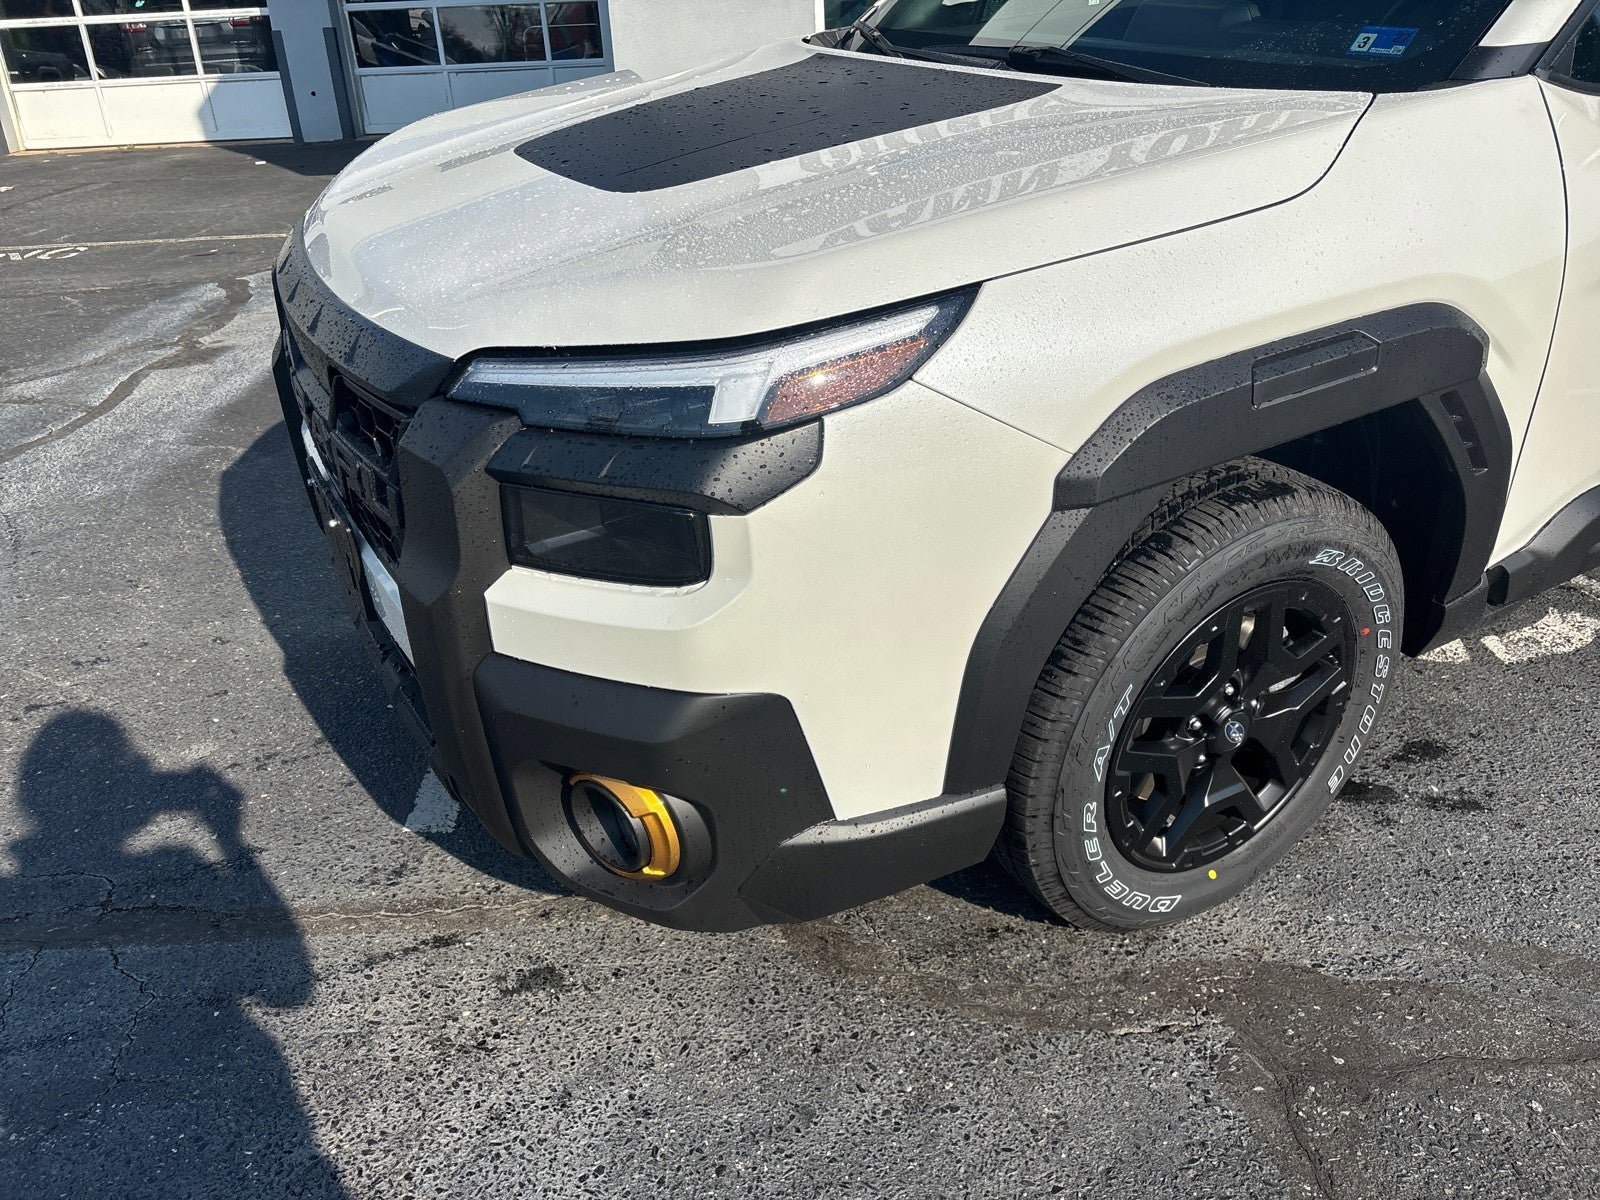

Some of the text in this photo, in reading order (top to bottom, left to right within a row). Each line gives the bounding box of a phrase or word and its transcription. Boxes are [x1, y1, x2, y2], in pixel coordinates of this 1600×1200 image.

[1357, 36, 1371, 49] 3
[1308, 548, 1392, 795] BRIDGESTONE
[1083, 801, 1182, 913] DUELER
